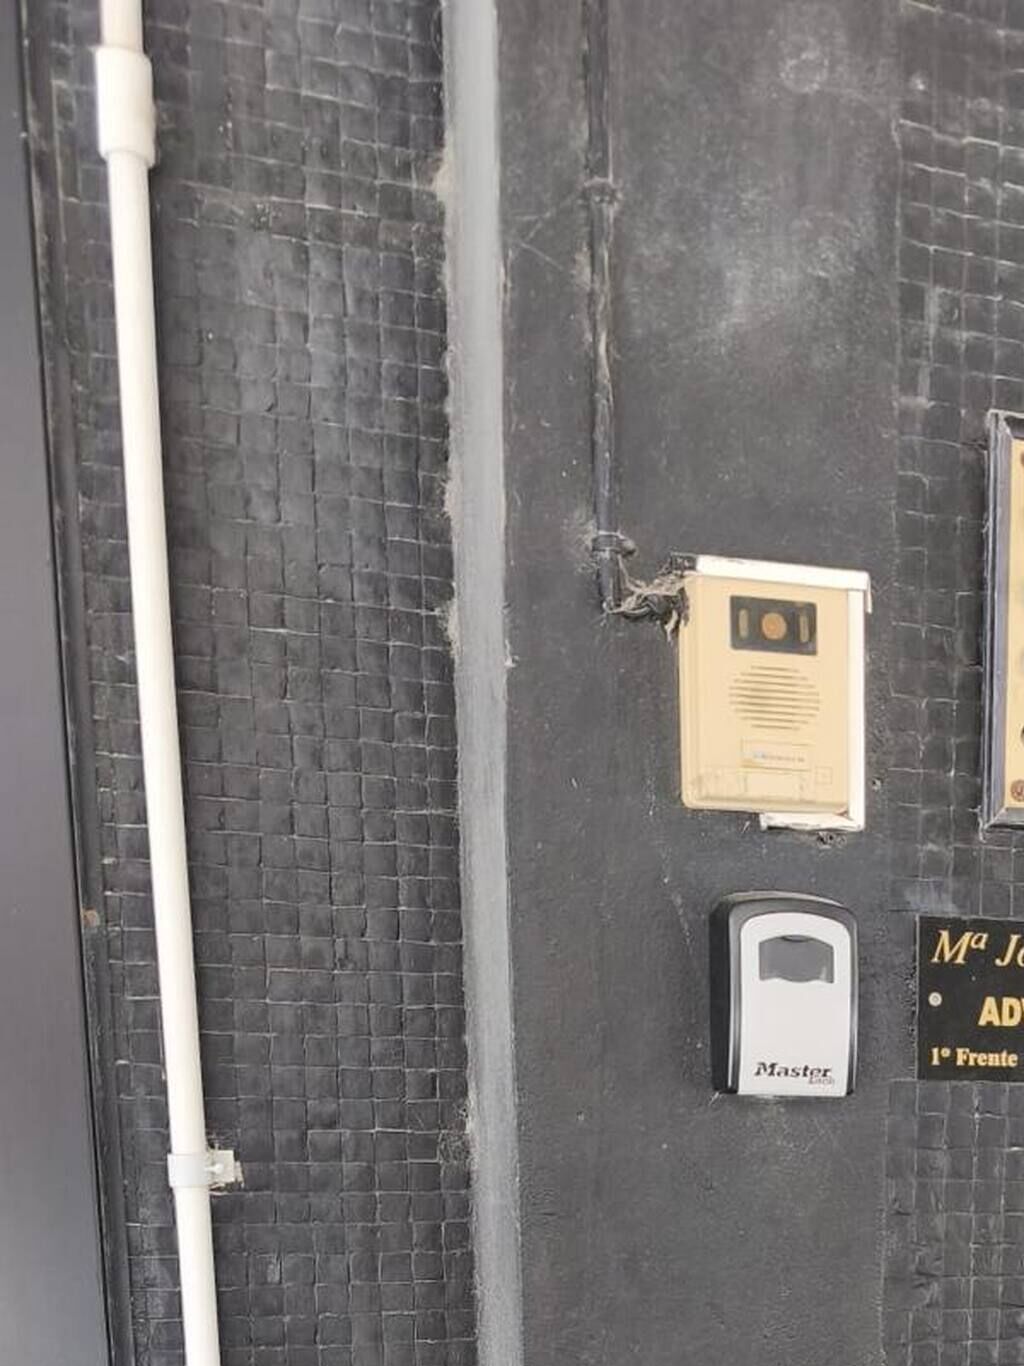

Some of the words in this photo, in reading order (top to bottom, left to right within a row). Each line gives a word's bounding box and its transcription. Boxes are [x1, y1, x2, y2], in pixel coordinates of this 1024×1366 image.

[930, 929, 989, 965] Mª
[956, 1048, 1018, 1068] Frente
[754, 1062, 832, 1078] Master
